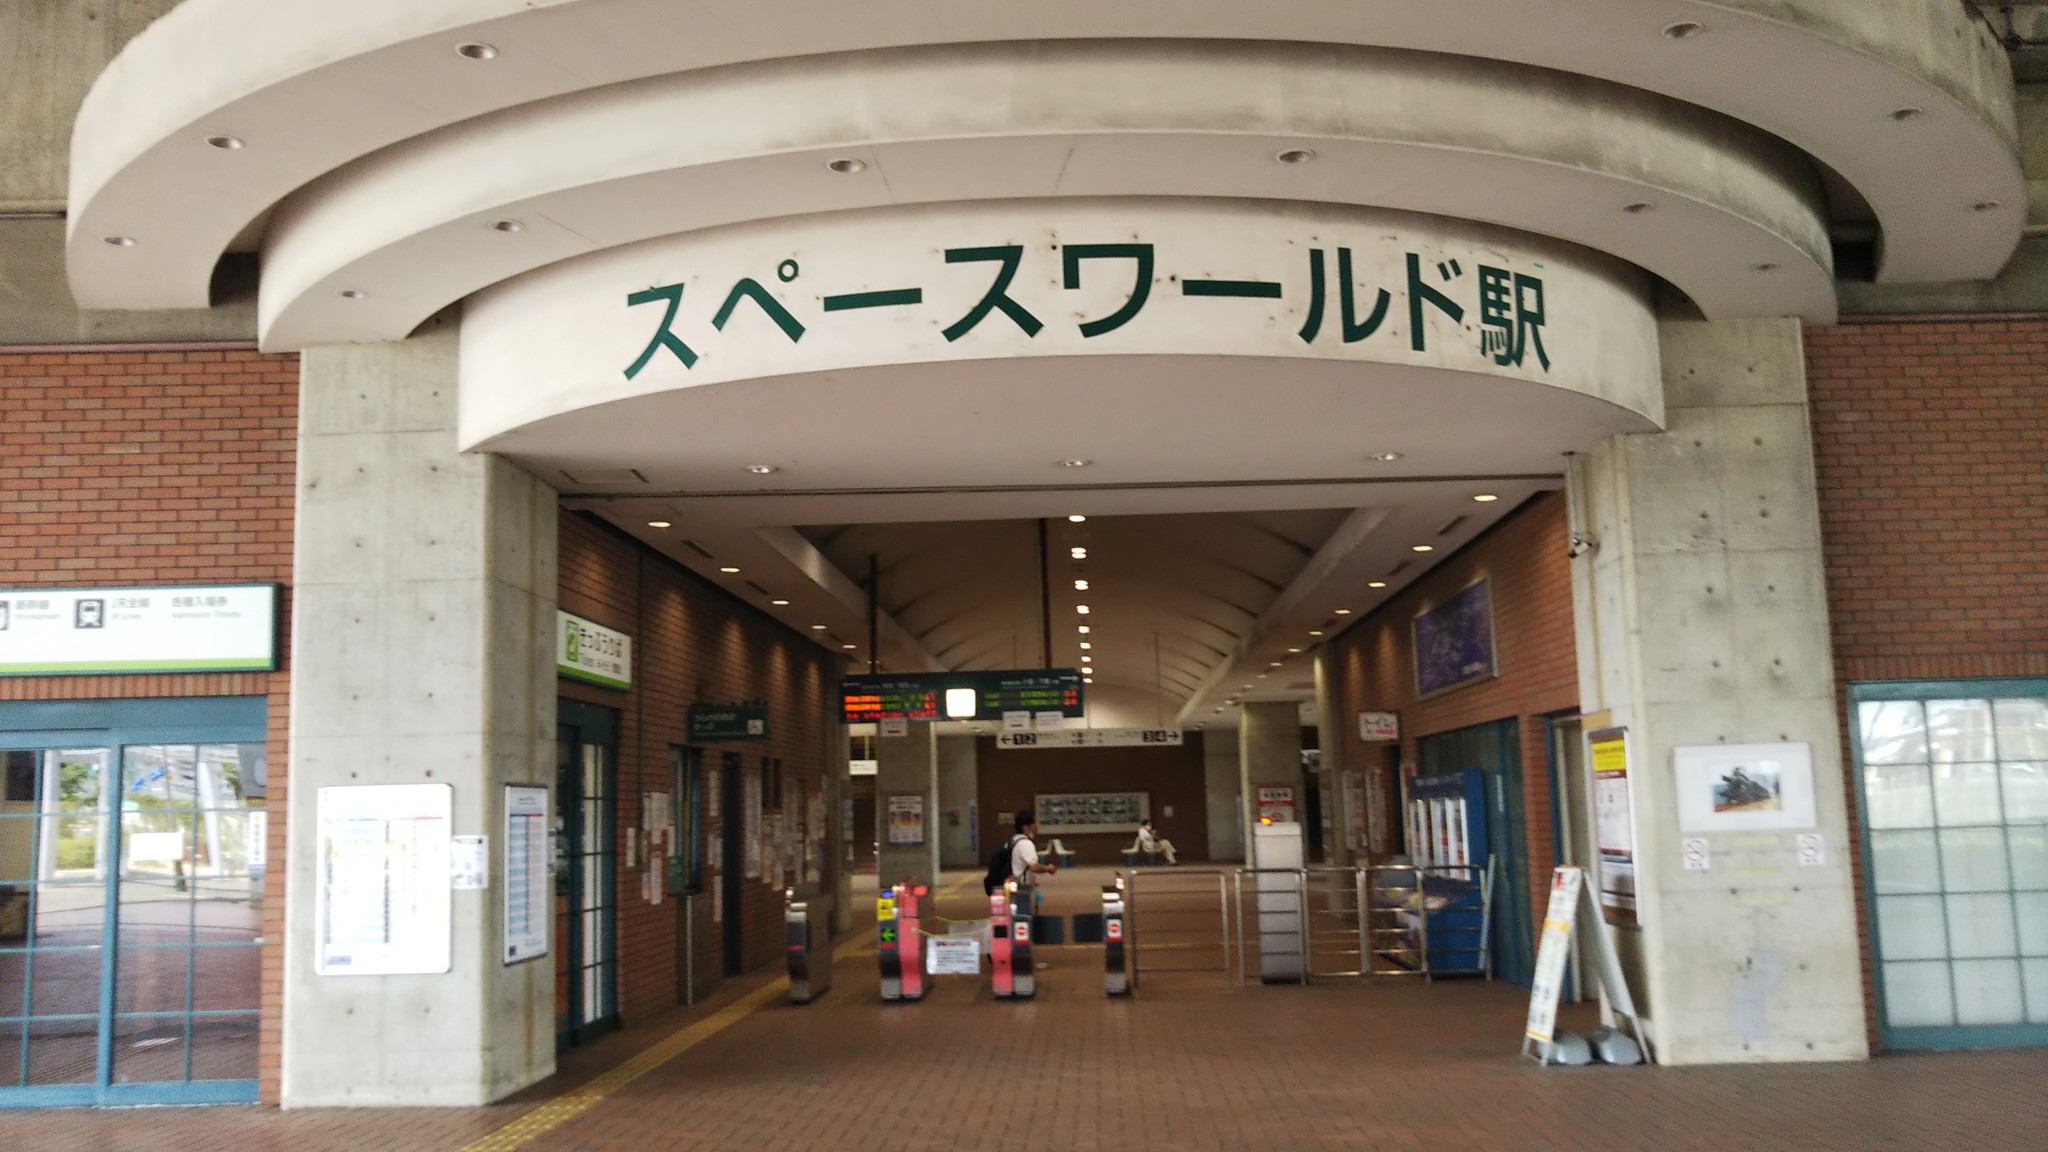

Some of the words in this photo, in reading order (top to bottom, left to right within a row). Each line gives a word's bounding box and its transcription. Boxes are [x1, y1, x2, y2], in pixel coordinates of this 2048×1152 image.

[622, 243, 1552, 381] スペースワールド駅
